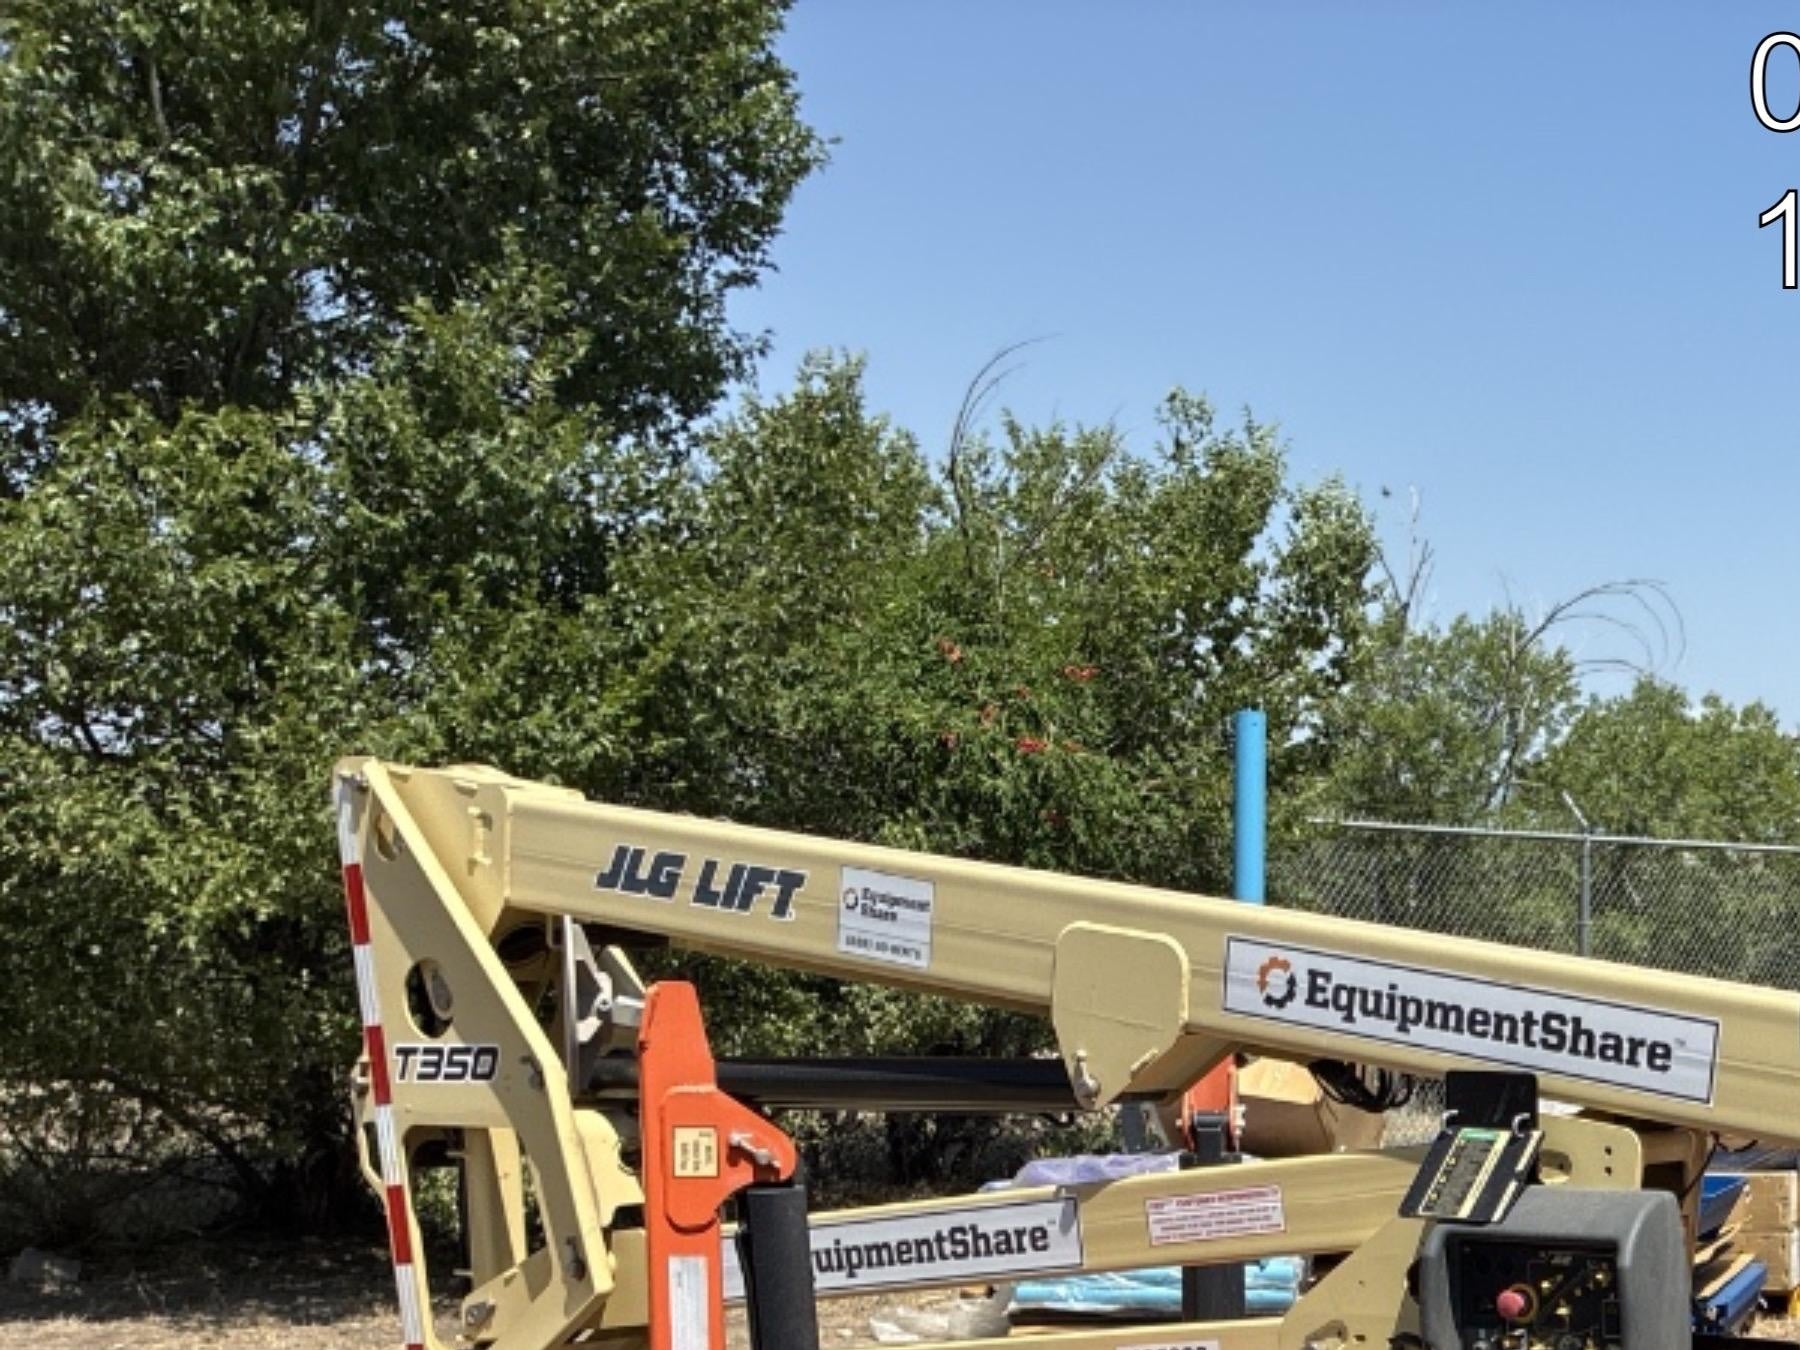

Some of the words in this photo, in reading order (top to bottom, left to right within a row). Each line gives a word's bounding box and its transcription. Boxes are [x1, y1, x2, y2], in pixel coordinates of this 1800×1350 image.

[597, 845, 687, 898] JLG
[692, 859, 806, 918] LIFT
[1304, 968, 1673, 1073] EquipmentShare
[395, 1046, 499, 1081] T350
[812, 1214, 1049, 1279] uipmentShare
